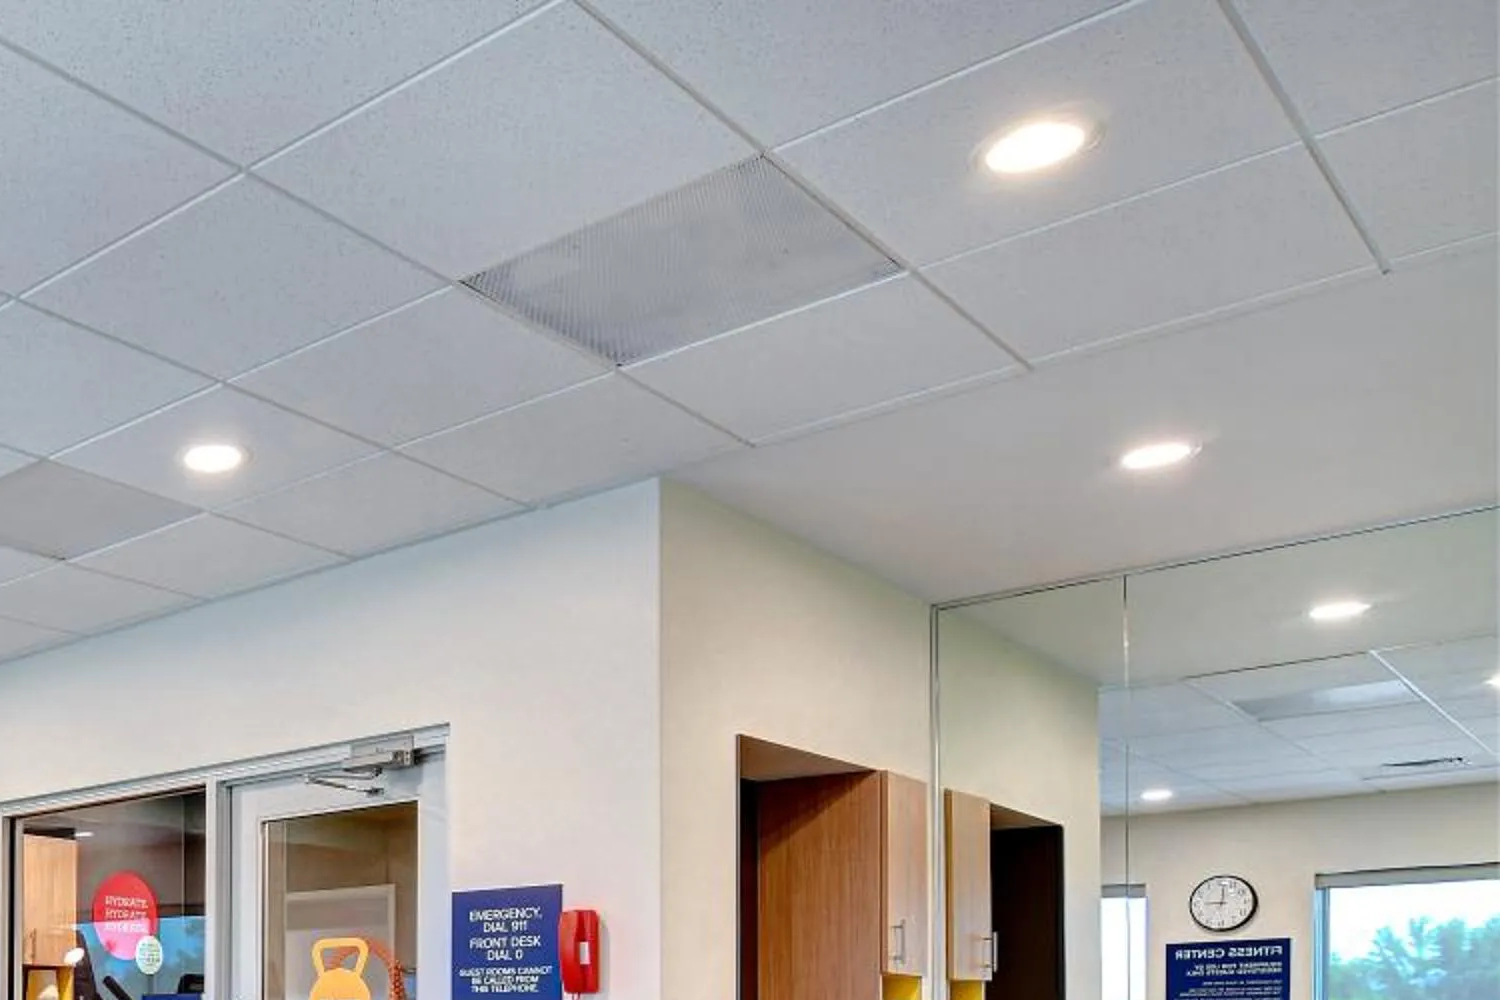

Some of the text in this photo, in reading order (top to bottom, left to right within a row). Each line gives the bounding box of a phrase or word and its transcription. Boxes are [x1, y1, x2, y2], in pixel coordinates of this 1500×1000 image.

[483, 920, 528, 933] DIAL 911
[469, 935, 541, 949] FRONT DESK
[487, 949, 512, 961] DIAL
[486, 966, 516, 976] ROOMS
[518, 965, 553, 975] CANNOT
[516, 975, 539, 984] FROM
